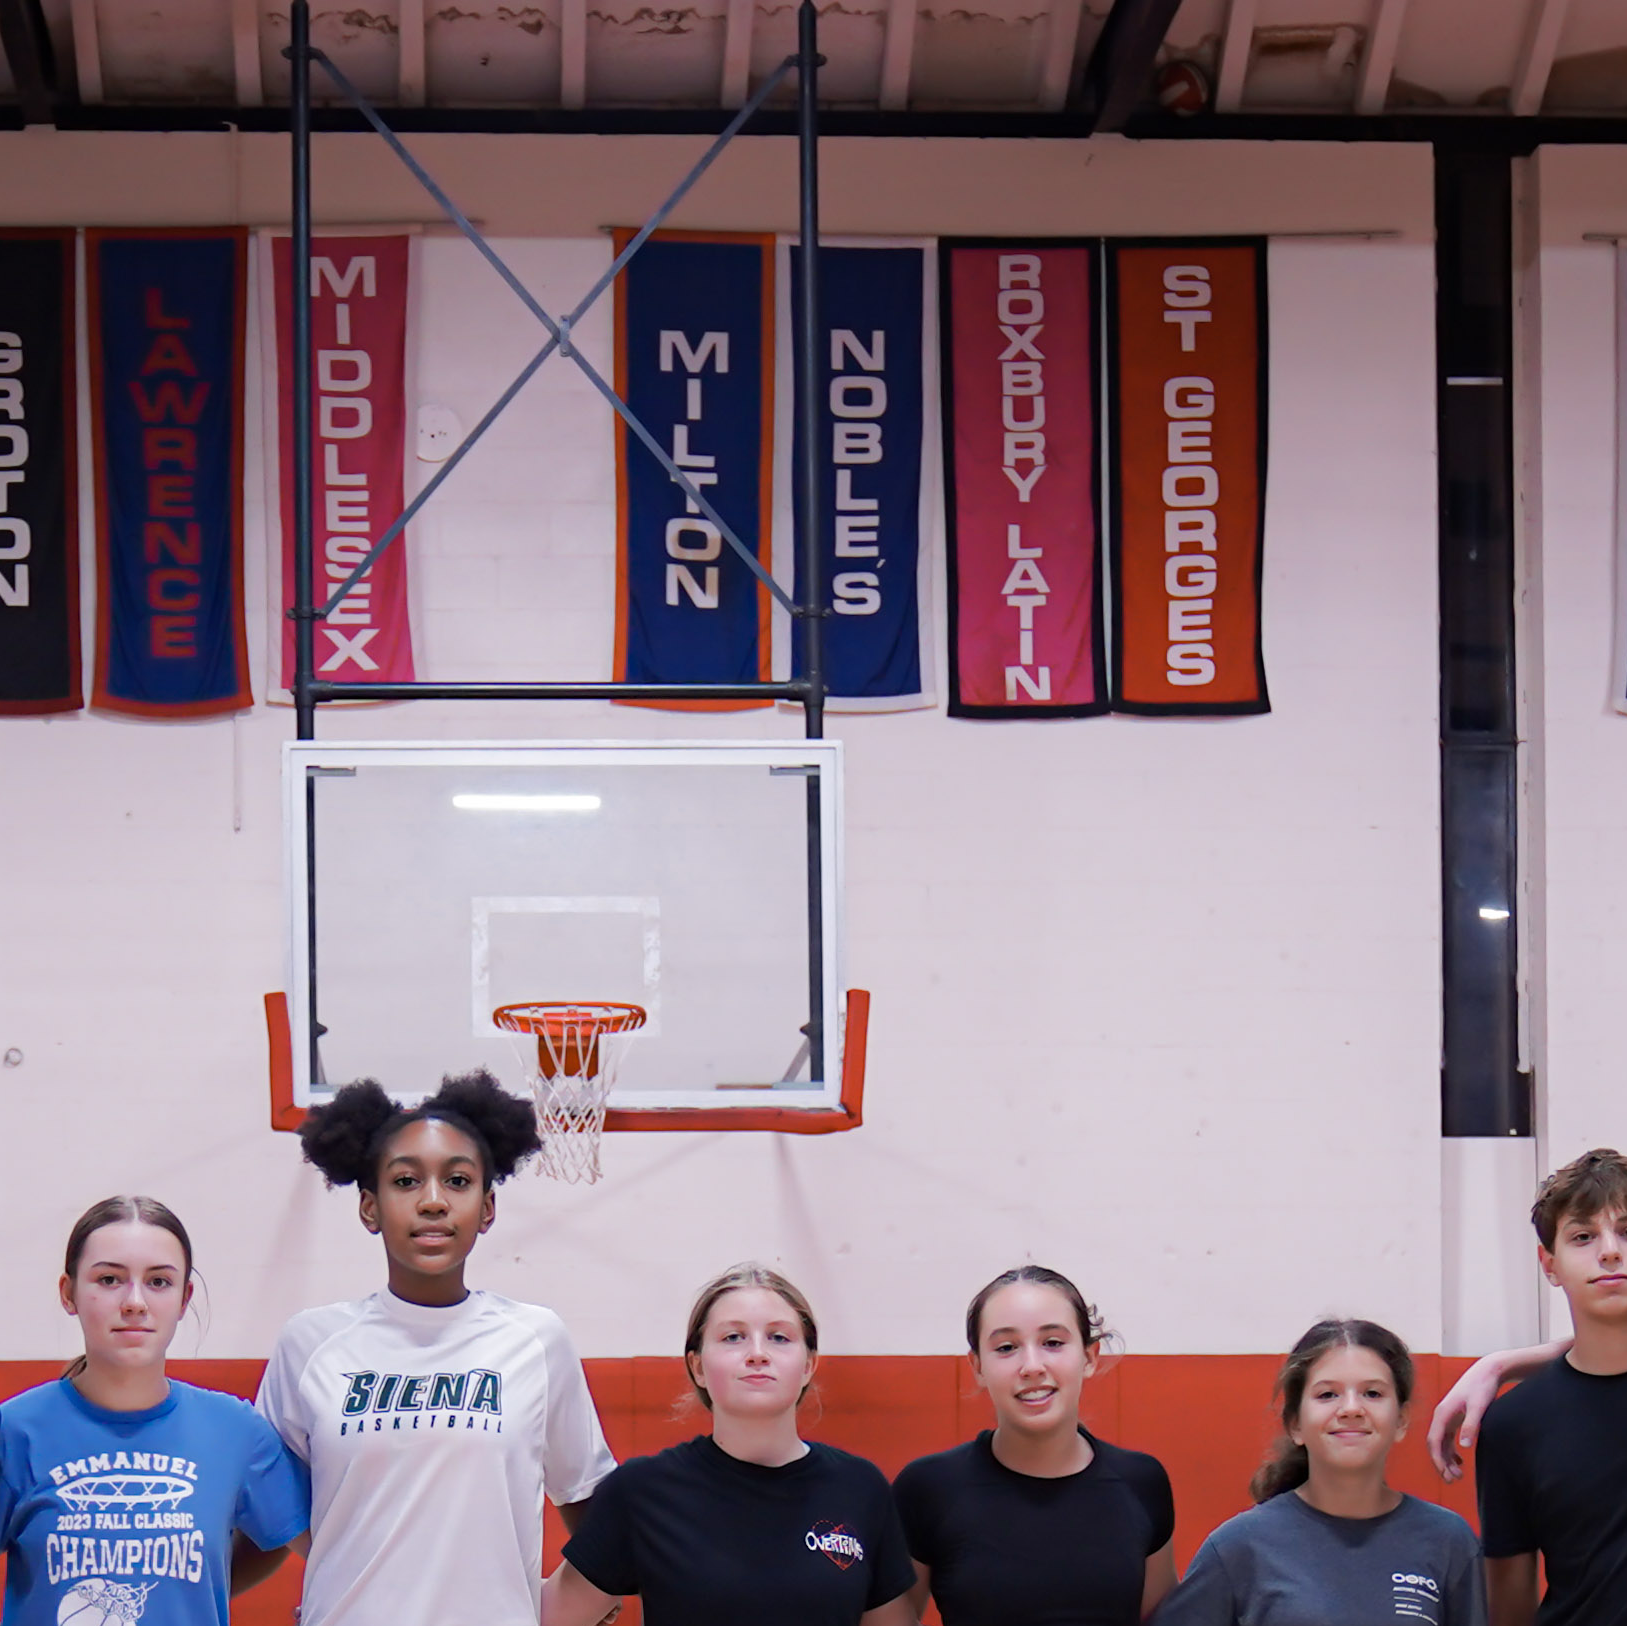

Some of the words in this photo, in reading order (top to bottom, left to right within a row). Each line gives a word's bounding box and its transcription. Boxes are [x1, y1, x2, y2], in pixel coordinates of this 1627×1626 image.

[1162, 265, 1213, 352] ST
[996, 254, 1048, 503] ROXBURY
[128, 287, 211, 658] LAWRENCE
[309, 255, 380, 672] MIDDLESEX
[659, 329, 729, 609] MILTON
[1162, 376, 1219, 687] GEORGES
[1000, 524, 1051, 701] LATIN
[340, 1369, 502, 1416] SIENA
[341, 1415, 502, 1436] BASKETBALL
[48, 1451, 199, 1486] EMMANUEL
[56, 1514, 92, 1531] 2023
[95, 1513, 131, 1530] FALL
[134, 1512, 194, 1530] CLASSIC
[46, 1530, 204, 1585] CHAMPIONS
